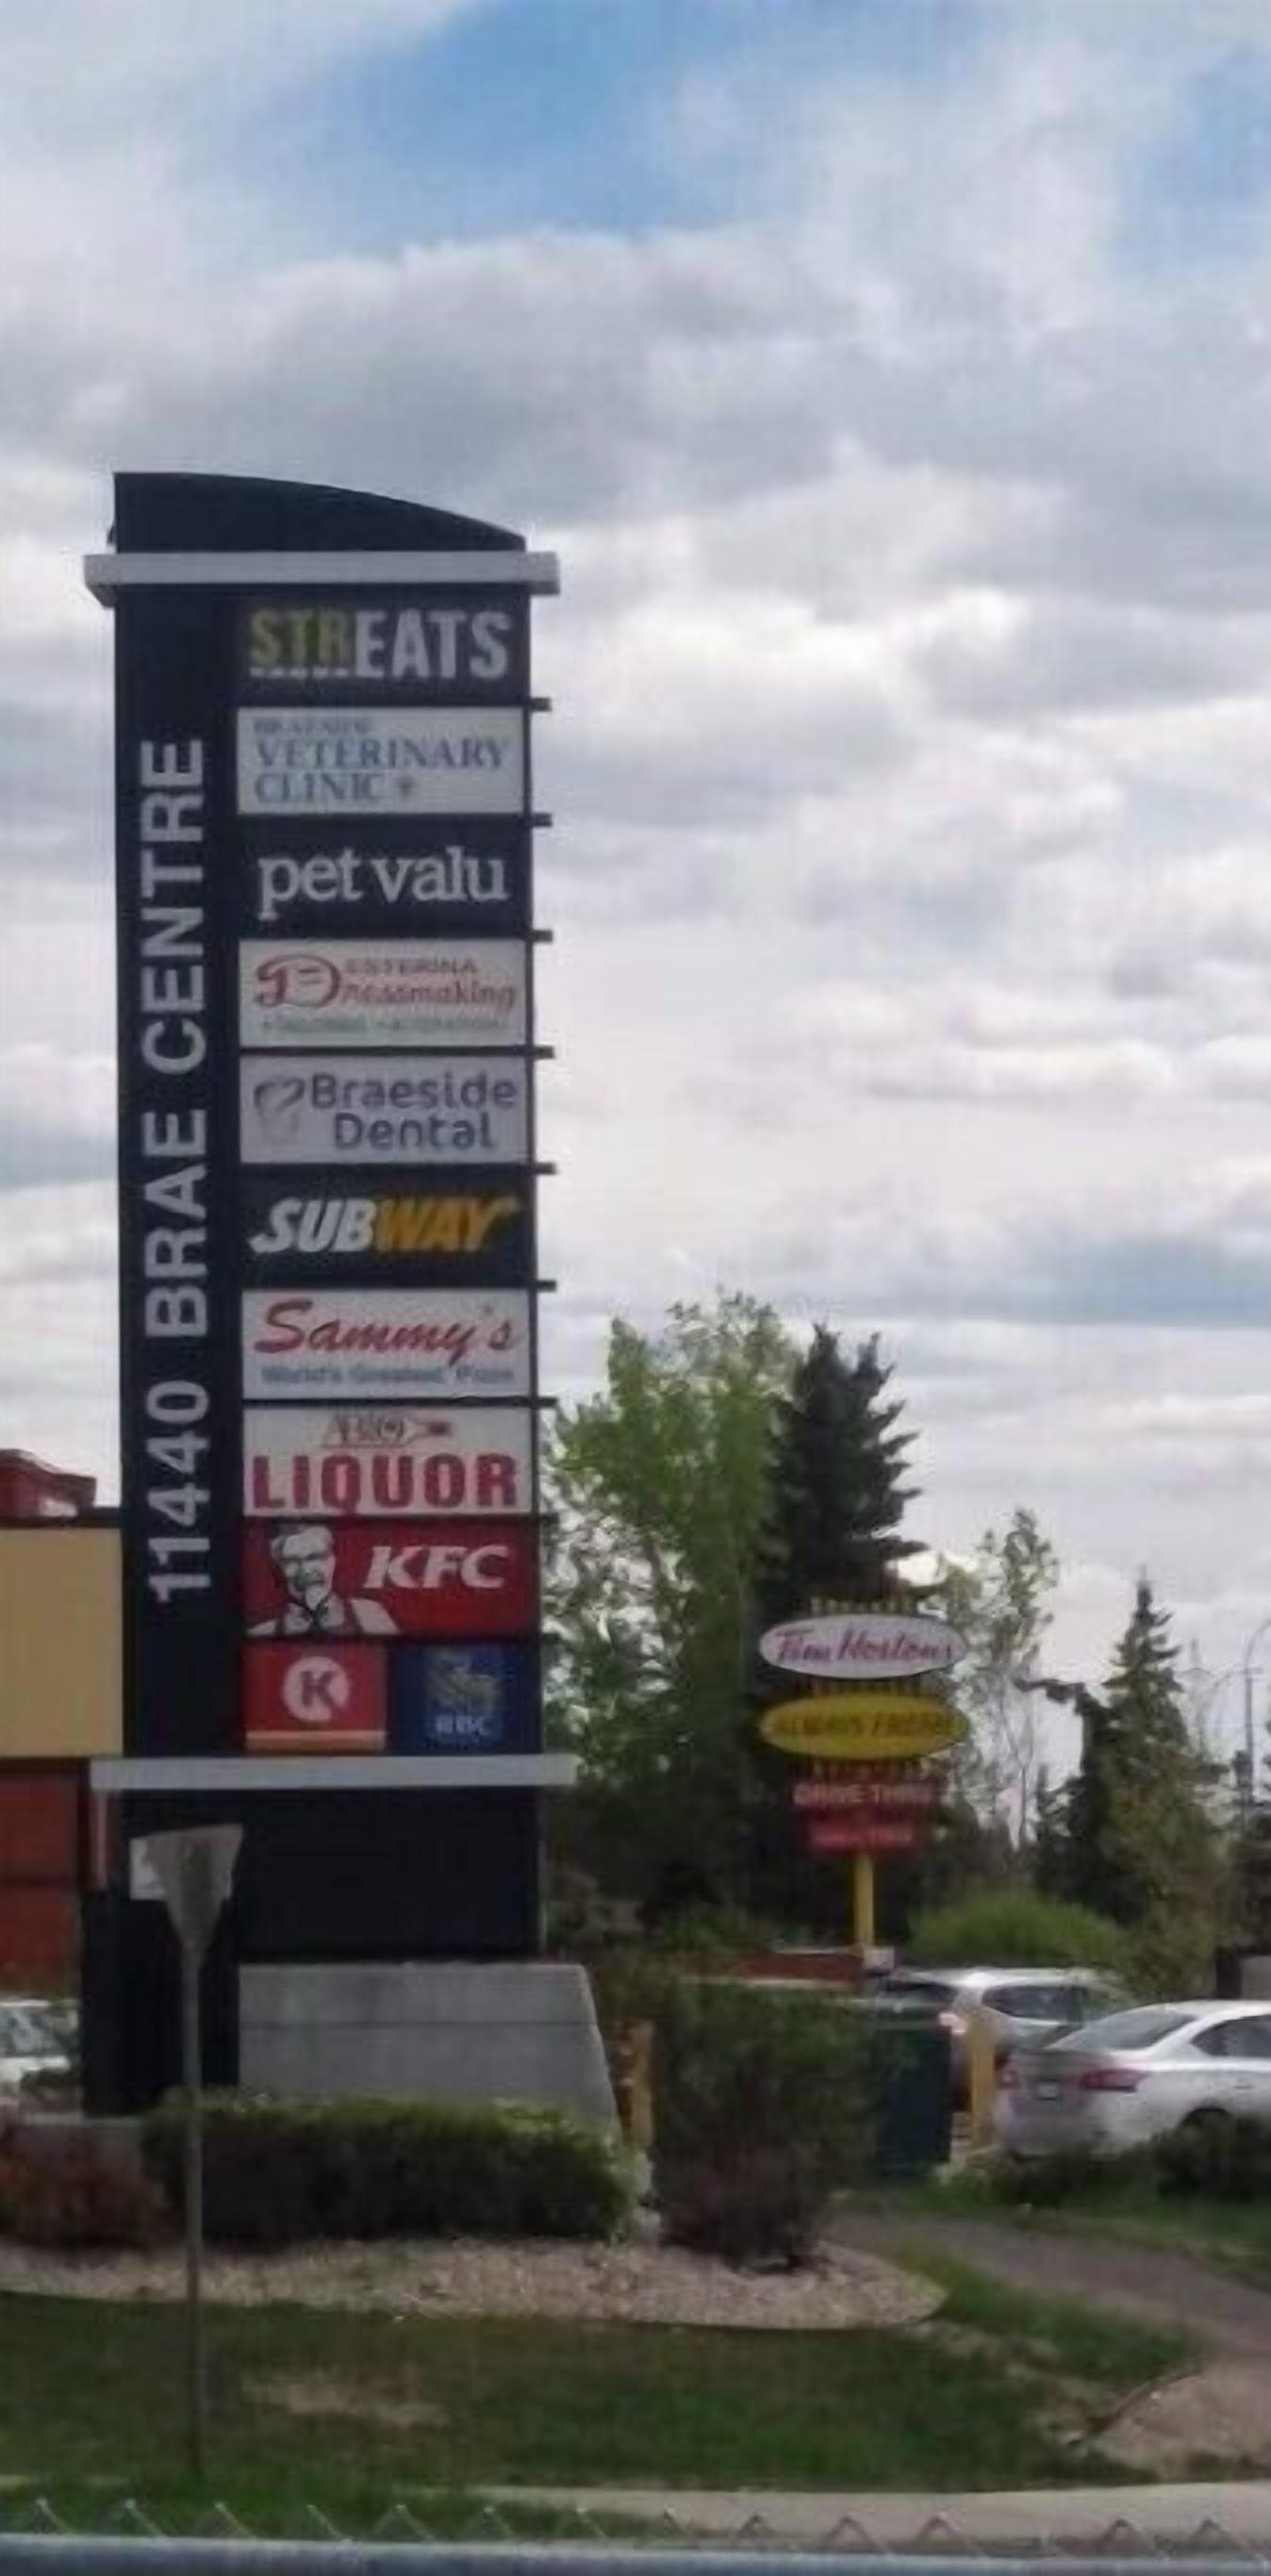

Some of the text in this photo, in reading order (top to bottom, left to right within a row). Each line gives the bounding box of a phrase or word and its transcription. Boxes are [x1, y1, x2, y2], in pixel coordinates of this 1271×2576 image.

[248, 607, 512, 679] STREATS
[256, 738, 510, 768] VETERINARY
[254, 772, 386, 801] CLINIC
[257, 845, 510, 920] pet valu
[310, 1072, 517, 1110] Braeside
[334, 1112, 496, 1149] Dental
[140, 740, 210, 1602] 11440 BRAE CENTRE
[249, 1194, 520, 1253] SUBWAY
[254, 1297, 514, 1368] Sammy's
[252, 1453, 517, 1512] LIQUOR
[363, 1544, 509, 1589] KFC
[775, 1626, 952, 1660] Tim Hortons
